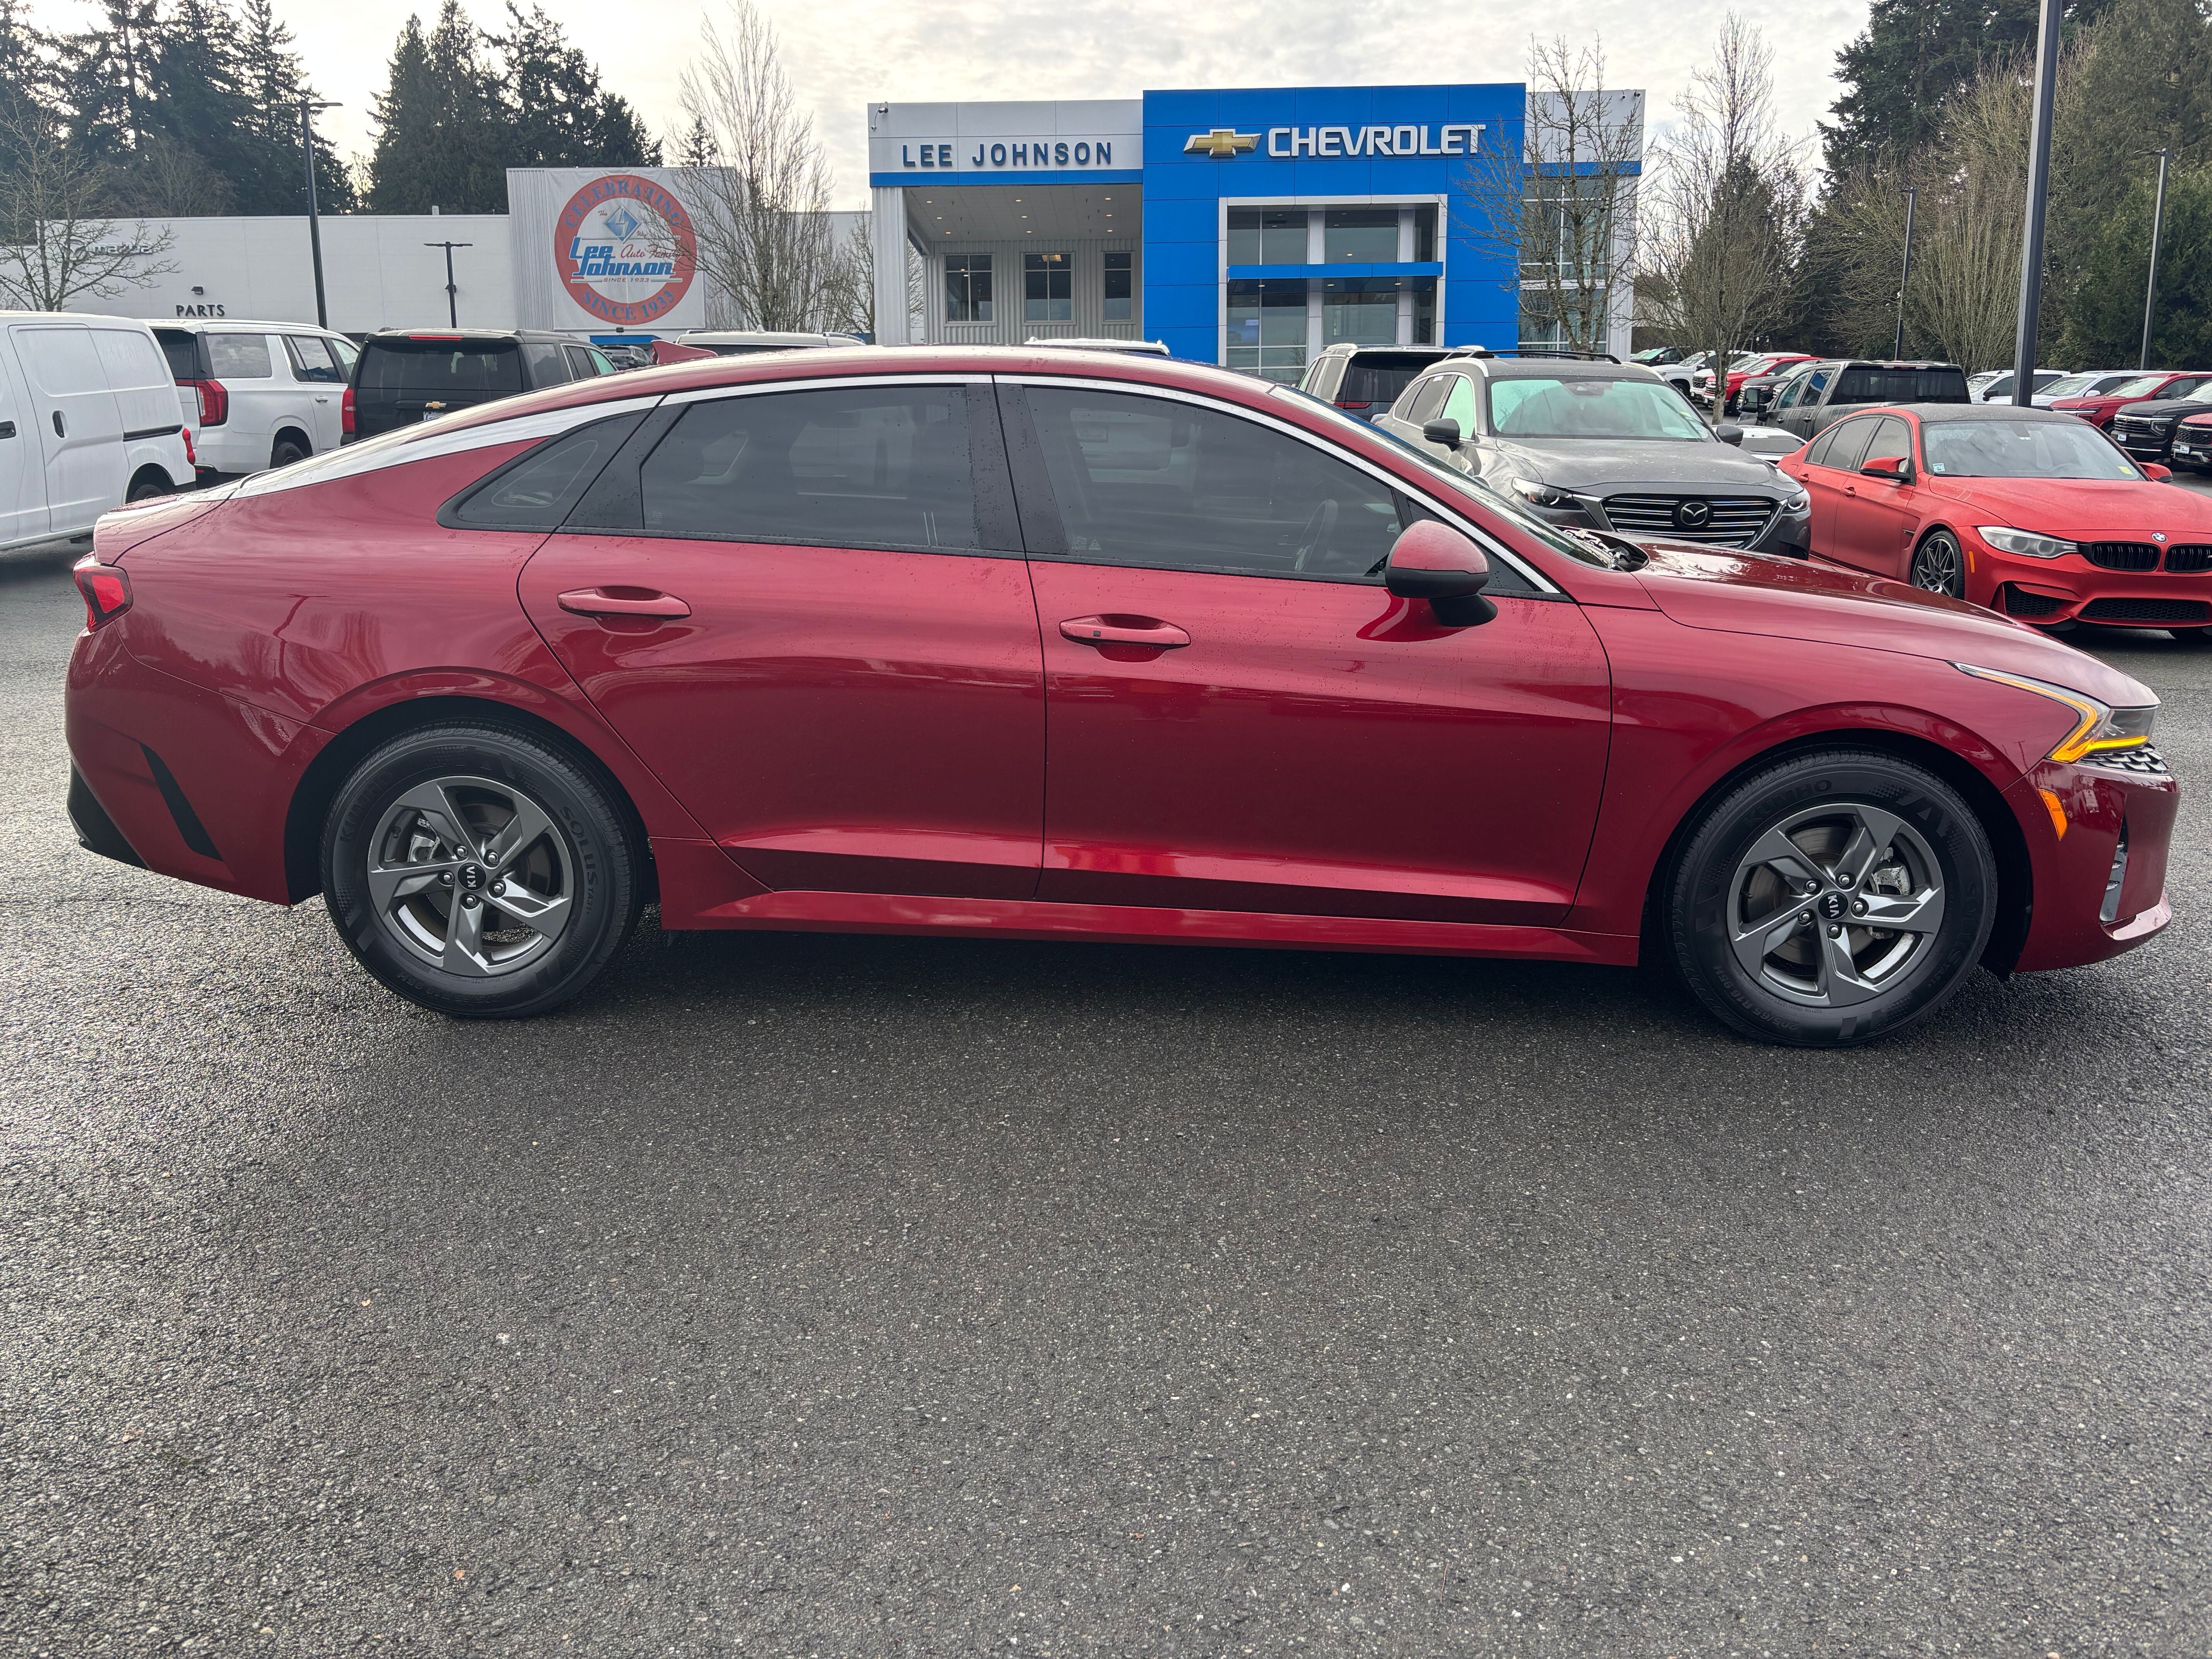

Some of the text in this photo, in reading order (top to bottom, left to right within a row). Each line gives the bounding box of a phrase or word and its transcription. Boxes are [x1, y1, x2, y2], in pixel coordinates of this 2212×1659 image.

[1268, 125, 1486, 157] CHEVROLET
[902, 142, 1111, 167] LEE JOHNSON
[564, 180, 684, 227] CELEBRATING
[92, 244, 153, 254] maa
[569, 237, 615, 259] Lee
[620, 244, 646, 258] Auto
[572, 254, 676, 276] Johnson
[175, 304, 225, 317] PARTS
[581, 289, 674, 320] SINCE 1933
[559, 806, 598, 886] SOLUS
[466, 866, 477, 887] KIA
[1827, 894, 1839, 917] KIA
[1713, 966, 1734, 989] 95H
[1731, 989, 1753, 1010] R16
[1752, 1007, 1800, 1030] 205/65
